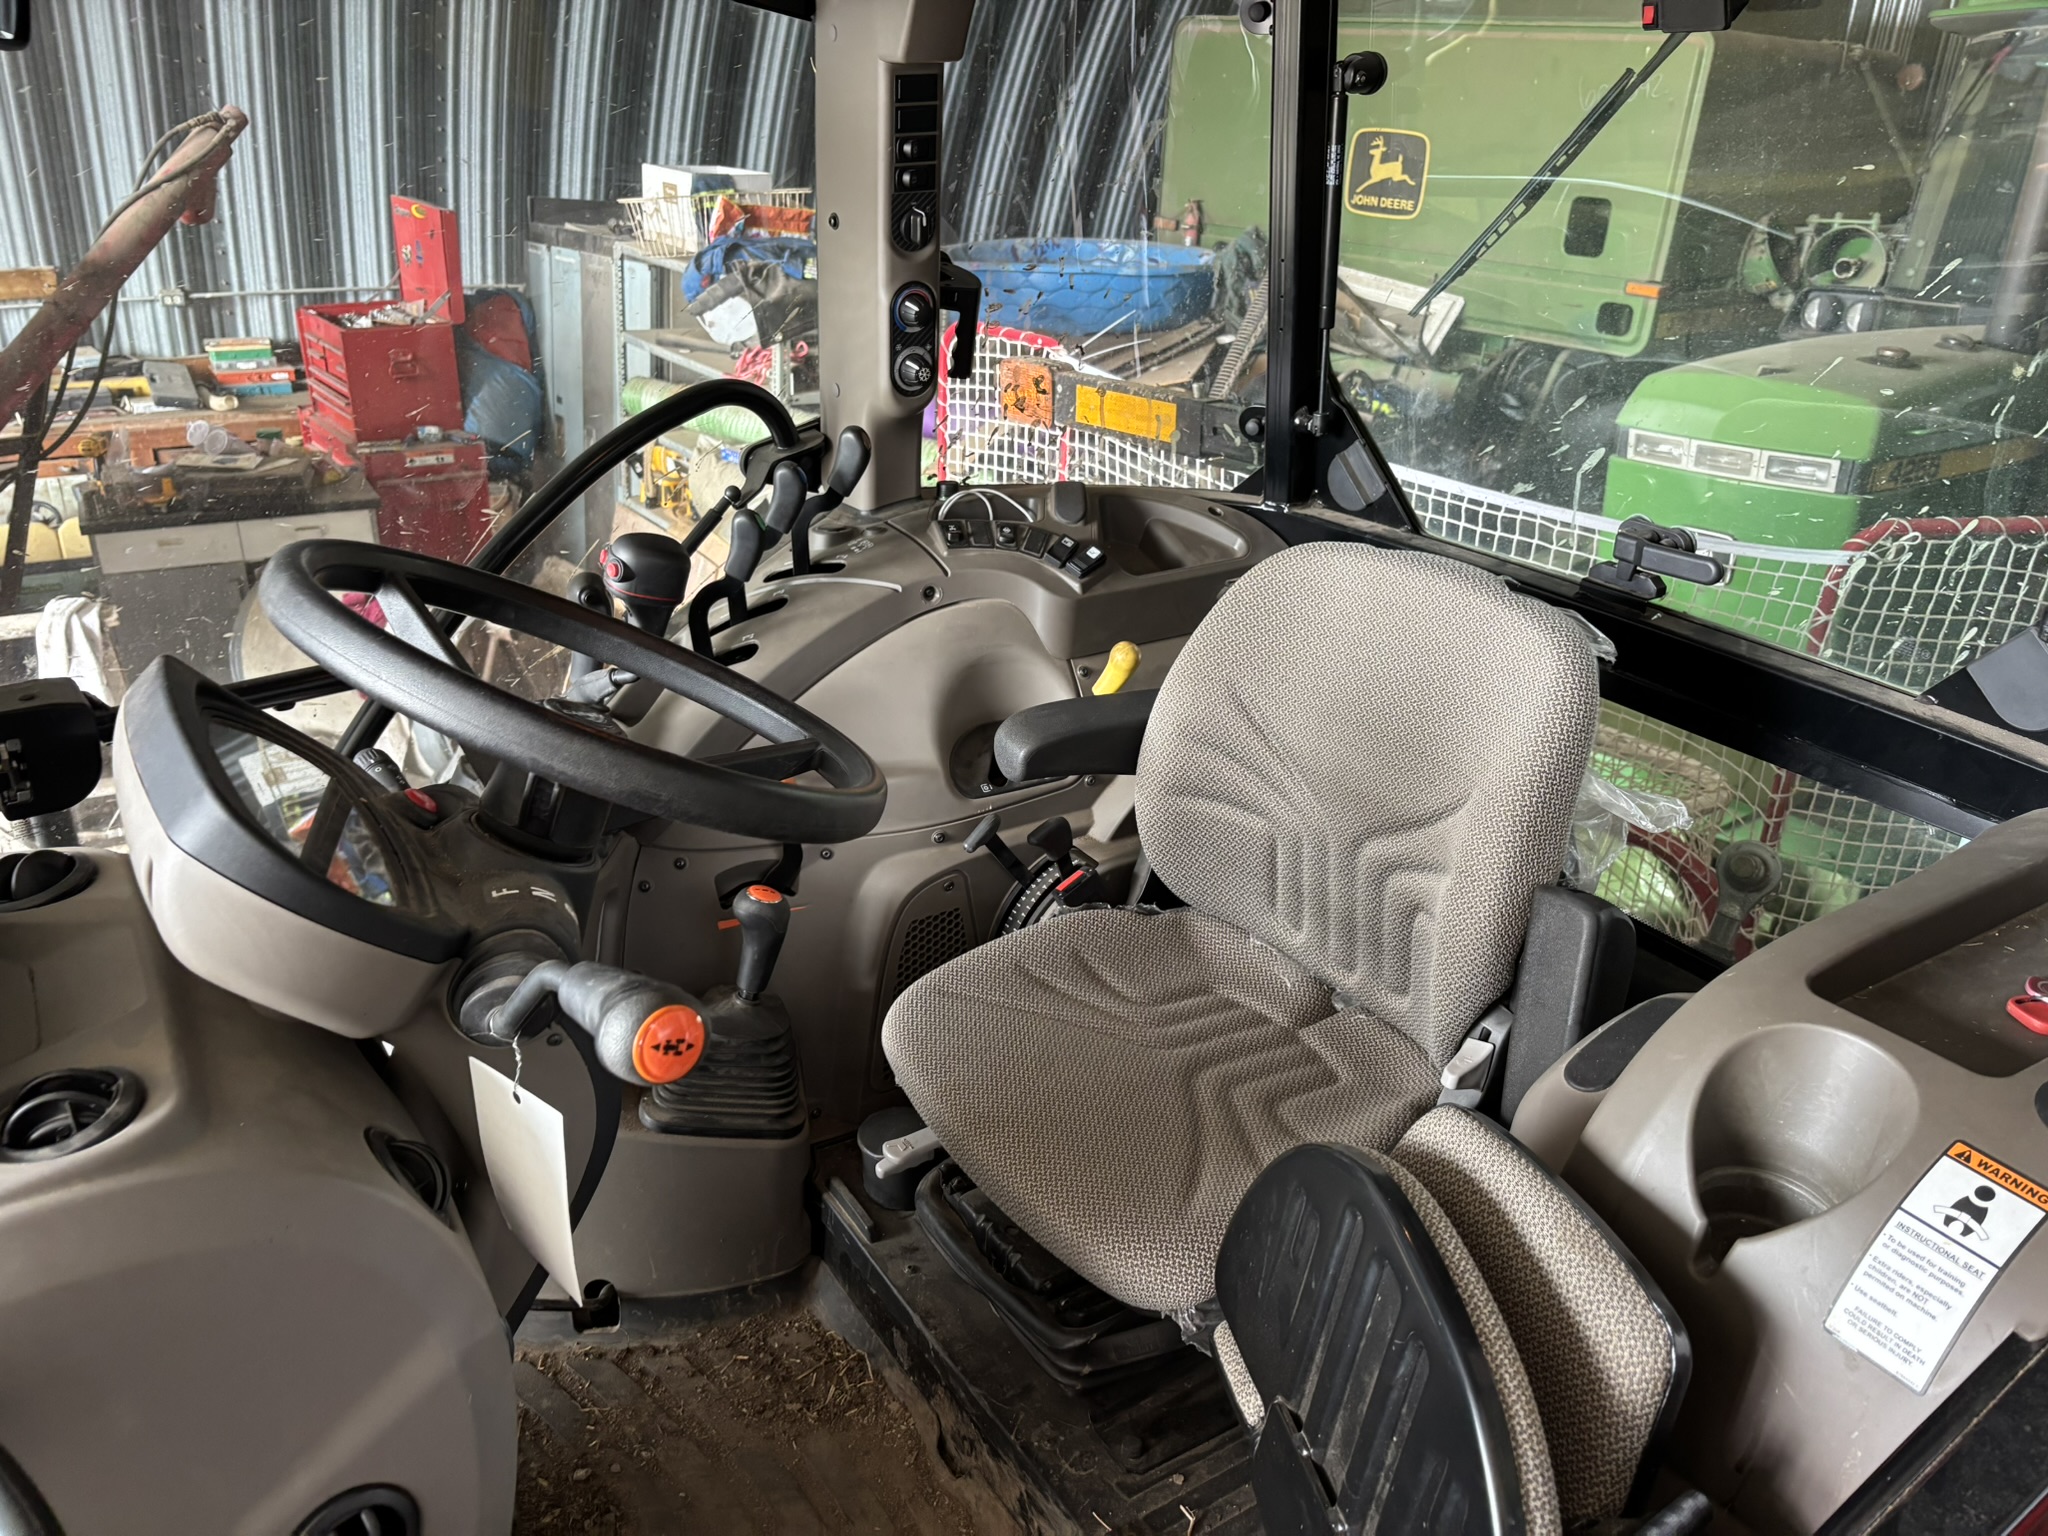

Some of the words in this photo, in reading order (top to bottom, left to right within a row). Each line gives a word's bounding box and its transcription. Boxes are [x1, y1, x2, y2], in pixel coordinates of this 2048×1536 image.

[1351, 194, 1379, 207] JOHN
[1379, 196, 1415, 211] DEERE
[1977, 1159, 2048, 1204] WARNING
[1882, 1242, 1891, 1250] or
[1891, 1248, 1928, 1273] diagnostic
[1928, 1271, 1964, 1297] purposes.
[1887, 1234, 1897, 1243] To
[1897, 1241, 1907, 1250] be
[1907, 1248, 1926, 1261] used
[1926, 1259, 1937, 1269] for
[1938, 1266, 1966, 1288] training
[1896, 1221, 1960, 1265] INSTRUCTIONAL
[1962, 1261, 1986, 1279] SEAT
[1854, 1284, 1868, 1297] Use
[1872, 1255, 1891, 1271] Extra
[1892, 1269, 1914, 1287] riders,
[1916, 1284, 1953, 1310] especially
[1899, 1283, 1912, 1294] are
[1912, 1291, 1929, 1305] NOT
[1854, 1306, 1883, 1327] FAILURE
[1883, 1325, 1893, 1335] TO
[1893, 1332, 1922, 1353] COMPLY
[1895, 1291, 1905, 1300] on
[1906, 1298, 1938, 1322] machine.
[1843, 1307, 1867, 1326] COULD
[1868, 1324, 1895, 1343] RESULT
[1902, 1347, 1926, 1366] DEATH
[1847, 1318, 1859, 1329] OR
[1859, 1326, 1888, 1349] SERIOUS
